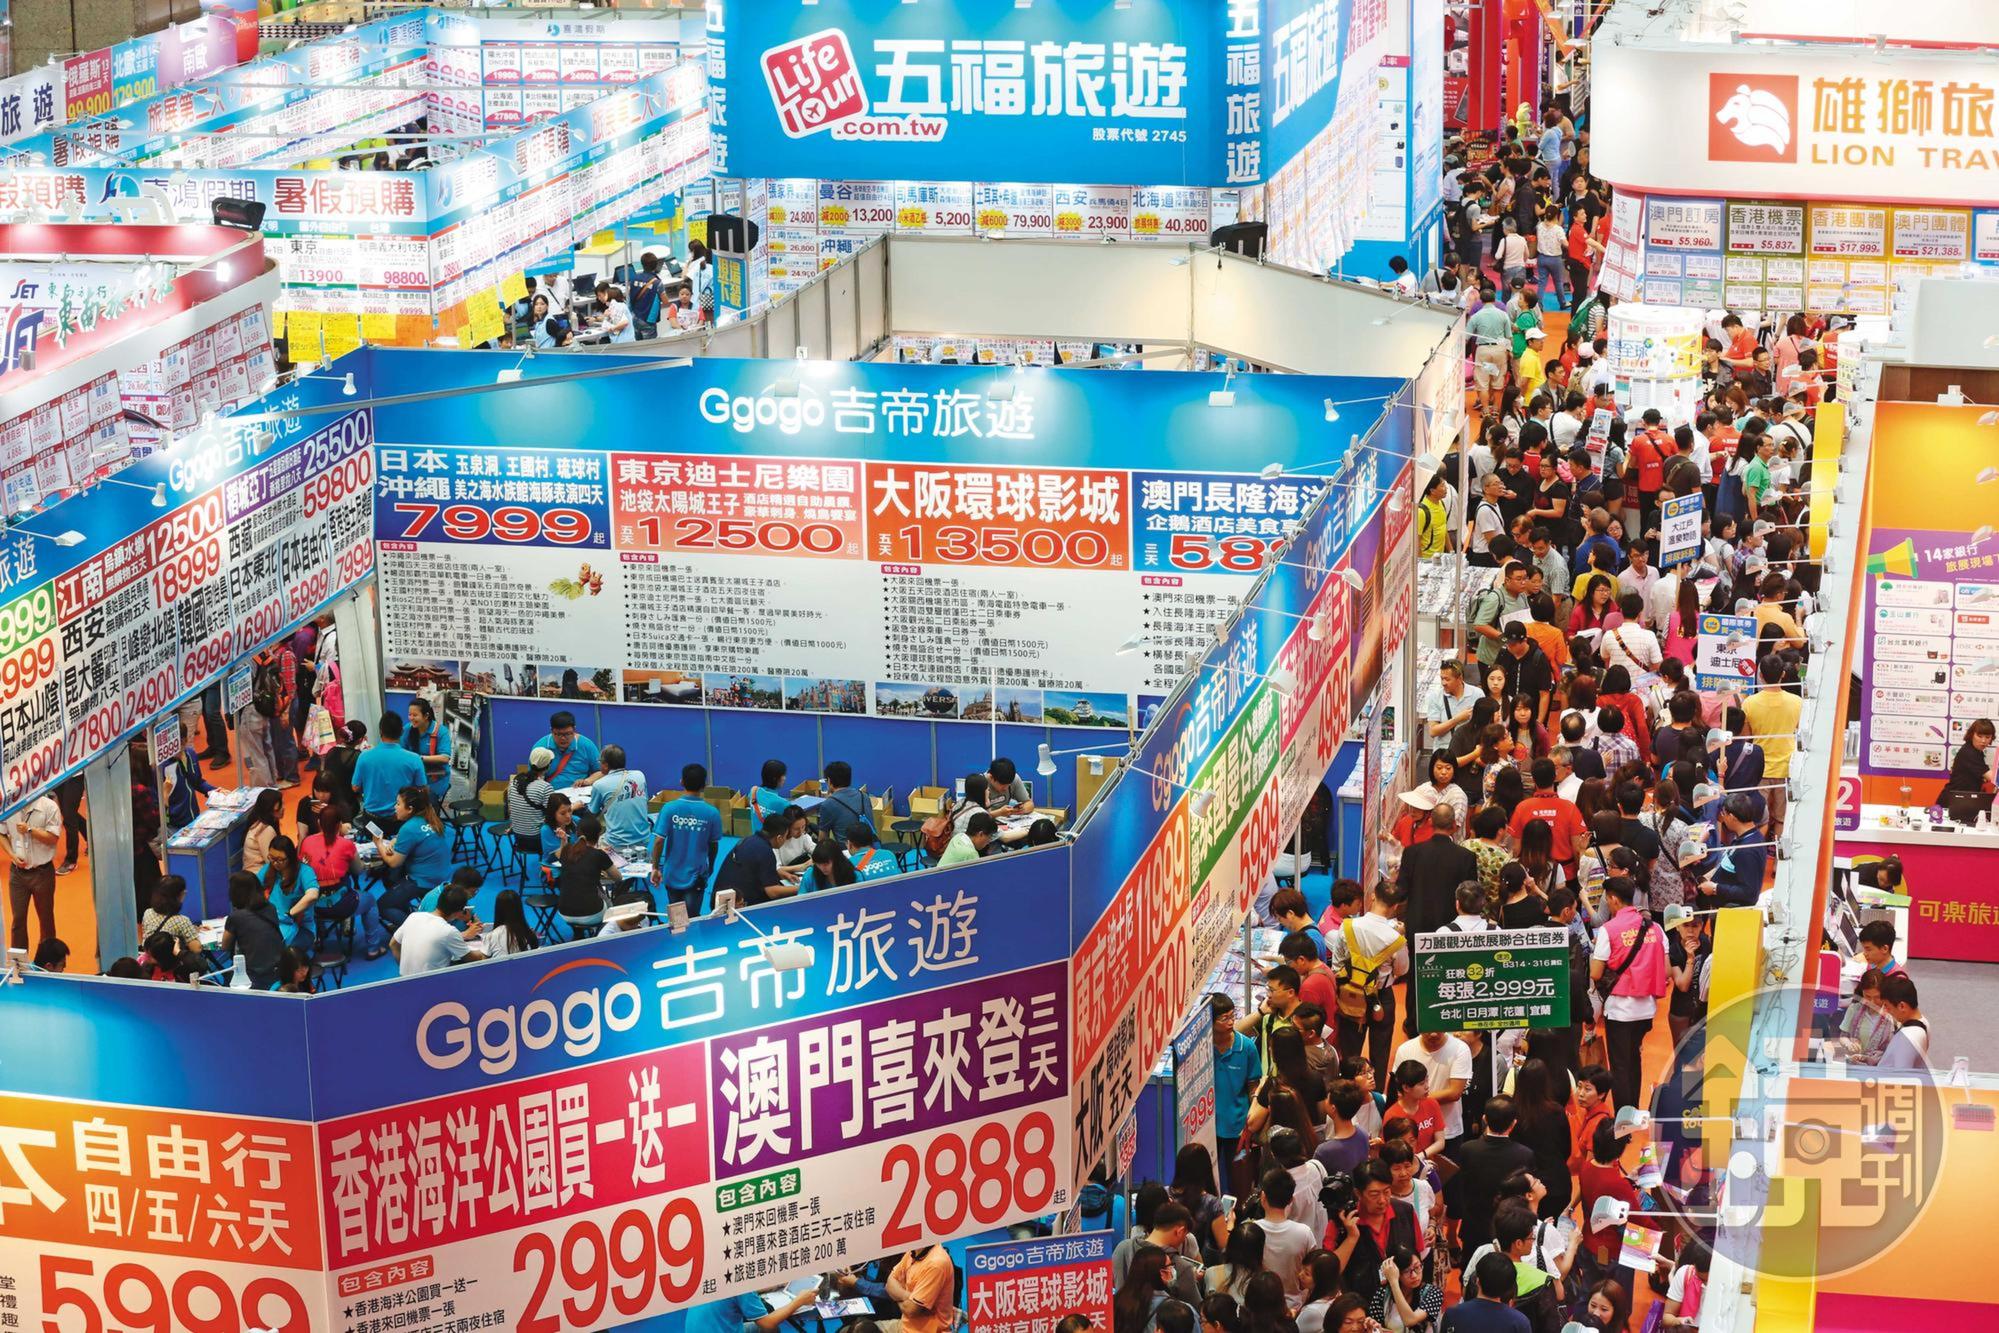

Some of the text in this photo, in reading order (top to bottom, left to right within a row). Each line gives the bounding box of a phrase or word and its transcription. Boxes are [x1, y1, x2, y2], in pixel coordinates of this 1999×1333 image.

[67, 58, 102, 86] 俄羅斯
[779, 41, 840, 98] Life
[874, 39, 1187, 119] 五福旅遊
[1272, 5, 1338, 128] 五福旅遊
[1, 82, 54, 136] 旅遊
[1226, 0, 1261, 183] 五福旅遊
[1812, 76, 1995, 138] 雄獅旅
[836, 117, 942, 138] .com.tw
[1092, 127, 1187, 143] 股票代號 2745
[1811, 144, 1895, 166] LION
[275, 177, 415, 216] 暑假預購
[819, 183, 853, 200] 曼谷
[897, 184, 939, 204] 司馬庫斯
[1055, 190, 1088, 206] 西安
[1133, 191, 1174, 208] 北海道
[790, 210, 816, 224] 24,800
[852, 208, 893, 224] 13,200
[935, 210, 971, 226] 5,200
[1013, 214, 1051, 229] 79,900
[1088, 215, 1128, 230] 23,900
[1165, 217, 1207, 233] 40,800
[1730, 207, 1801, 225] 香港機票
[290, 239, 318, 255] 東京
[821, 238, 852, 253] 沖繩
[1678, 236, 1711, 247] $5,960
[1760, 240, 1793, 250] $5,837
[1839, 243, 1878, 253] $17,999
[1921, 246, 1960, 256] $21,388
[300, 269, 344, 282] 13900
[700, 386, 1035, 440] Ggogo 吉帝旅遊
[303, 409, 369, 479] 25500
[380, 449, 600, 481] 日本 琉球村
[303, 450, 371, 519] 59800
[378, 474, 604, 506] 沖繩 美之海水族館海豚表演四天
[617, 459, 855, 493] 東京迪士尼樂園
[873, 468, 1121, 525] 大阪環球影城
[620, 488, 740, 516] 池袋太陽城王子
[147, 495, 221, 567] 12500
[229, 517, 253, 563] 西藏
[394, 503, 606, 545] 7999 起
[620, 515, 860, 554] 五天 12500 起
[1667, 532, 1697, 546] 溫泉物語
[1671, 519, 1694, 532] 大江戶
[281, 522, 329, 587] 日本自由行
[335, 537, 373, 590] 7999
[878, 524, 1124, 567] 五天 13500 起
[1144, 543, 1159, 566] 三天
[1924, 544, 1978, 563] 14家銀行
[56, 560, 105, 619] 江南
[152, 537, 221, 609] 18999
[230, 545, 277, 600] 日本東北
[289, 567, 329, 621] 5999
[60, 606, 105, 662] 西安
[177, 586, 208, 652] 韓國
[234, 598, 283, 656] 16900
[64, 645, 106, 707] 昆大麗
[183, 630, 233, 689] 6999
[0, 680, 60, 749] 日本山陰
[126, 664, 177, 729] 24900
[1152, 620, 1259, 813] Ggogo 吉帝旅遊
[1317, 656, 1349, 768] 4999
[67, 700, 122, 766] 27800
[9, 738, 63, 802] 31900
[1836, 780, 1853, 811] 2
[672, 814, 698, 825] Ggogo
[1240, 774, 1280, 914] 5999
[1135, 812, 1186, 972] 11999
[1419, 931, 1565, 950] 力麗觀光旅展聯合住宿券
[416, 889, 980, 1076] Ggogo 吉帝旅遊
[1075, 887, 1134, 1067] 東京 迪士尼
[1437, 977, 1555, 1001] 每張2,999元
[1445, 966, 1495, 979] 狂殺32折
[1440, 1004, 1552, 1020] 台北 日月潭 花蓮 宜蘭
[719, 992, 1060, 1166] 澳門喜來登 三天
[1075, 1052, 1105, 1188] 大阪
[71, 1116, 293, 1191] 自由行
[330, 1064, 698, 1258] 香港海洋公園買一送一
[718, 1173, 798, 1209] 包含內容
[880, 1111, 1068, 1250] 2888 起
[84, 1183, 293, 1257] 四/五/六天
[732, 1196, 822, 1237] 澳門來回機票一張
[733, 1205, 877, 1260] 澳門喜來登酒店三天二夜住宿
[513, 1196, 718, 1333] 2999 起
[734, 1237, 848, 1285] 旅遊意外責任險 200 萬
[974, 1237, 1105, 1271] Ggogo 吉帝旅遊
[39, 1254, 312, 1333] 5999
[340, 1259, 430, 1294] 包含內容
[355, 1277, 479, 1318] 香港海洋公園買一送一
[971, 1266, 1108, 1321] 大阪環球影城
[356, 1300, 457, 1333] 香港來回機票一張
